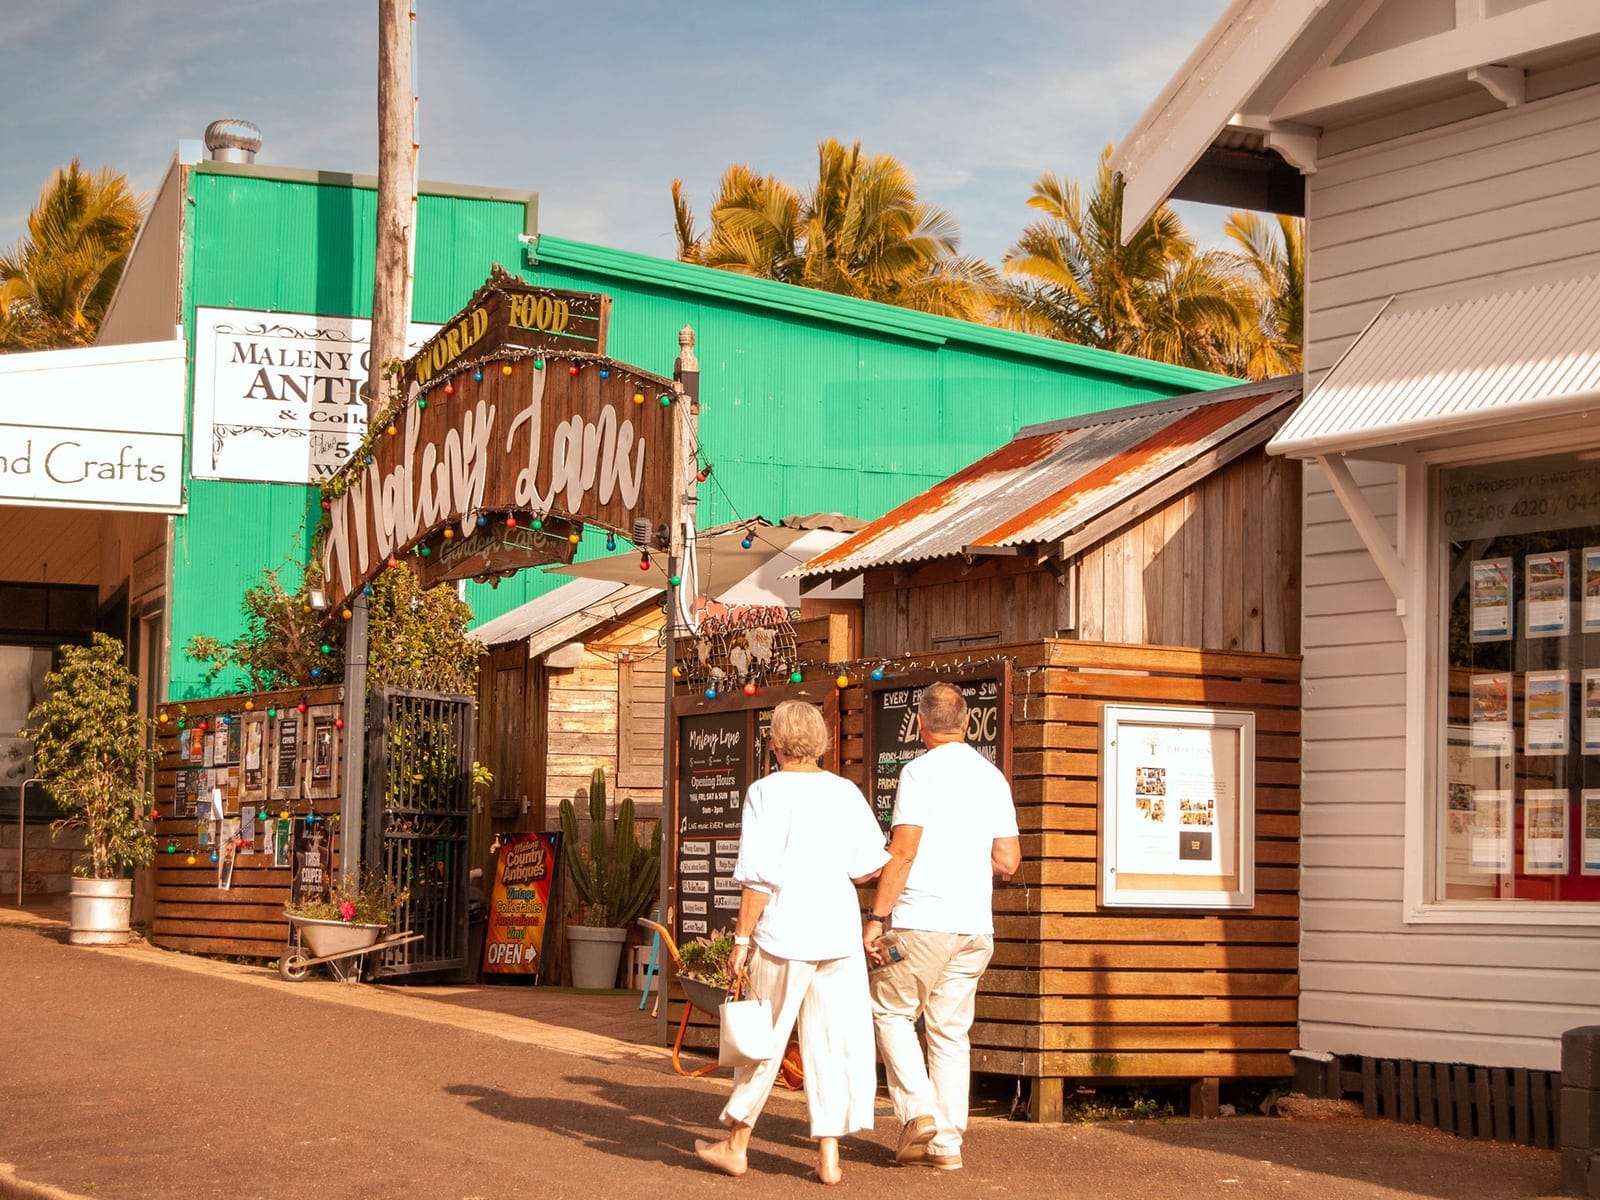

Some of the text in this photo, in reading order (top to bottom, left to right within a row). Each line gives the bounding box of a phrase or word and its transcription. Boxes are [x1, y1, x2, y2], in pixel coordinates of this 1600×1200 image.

[416, 293, 569, 385] WORLD FOOD
[230, 341, 353, 371] MALENY
[278, 409, 299, 421] &
[310, 433, 336, 456] Phone
[45, 441, 166, 484] Crafts
[325, 355, 646, 597] Maleny Lane
[1445, 483, 1473, 498] YOUR
[1475, 476, 1533, 492] PROPERTY
[1550, 469, 1591, 485] WORTH
[1444, 509, 1462, 527] 07
[1511, 498, 1549, 517] 4220
[1567, 492, 1600, 511] 044
[884, 690, 910, 706] EVERY
[962, 688, 976, 696] AND
[689, 728, 719, 755] Maleny
[720, 727, 740, 748] Lane
[691, 773, 736, 790] Opening Hours
[719, 791, 728, 800] SUN
[507, 849, 545, 867] Country
[503, 864, 545, 882] Antiques
[506, 888, 535, 901] Vintage
[496, 900, 543, 914] Collectables
[507, 927, 526, 941] Vinyl
[488, 943, 523, 965] OPEN
